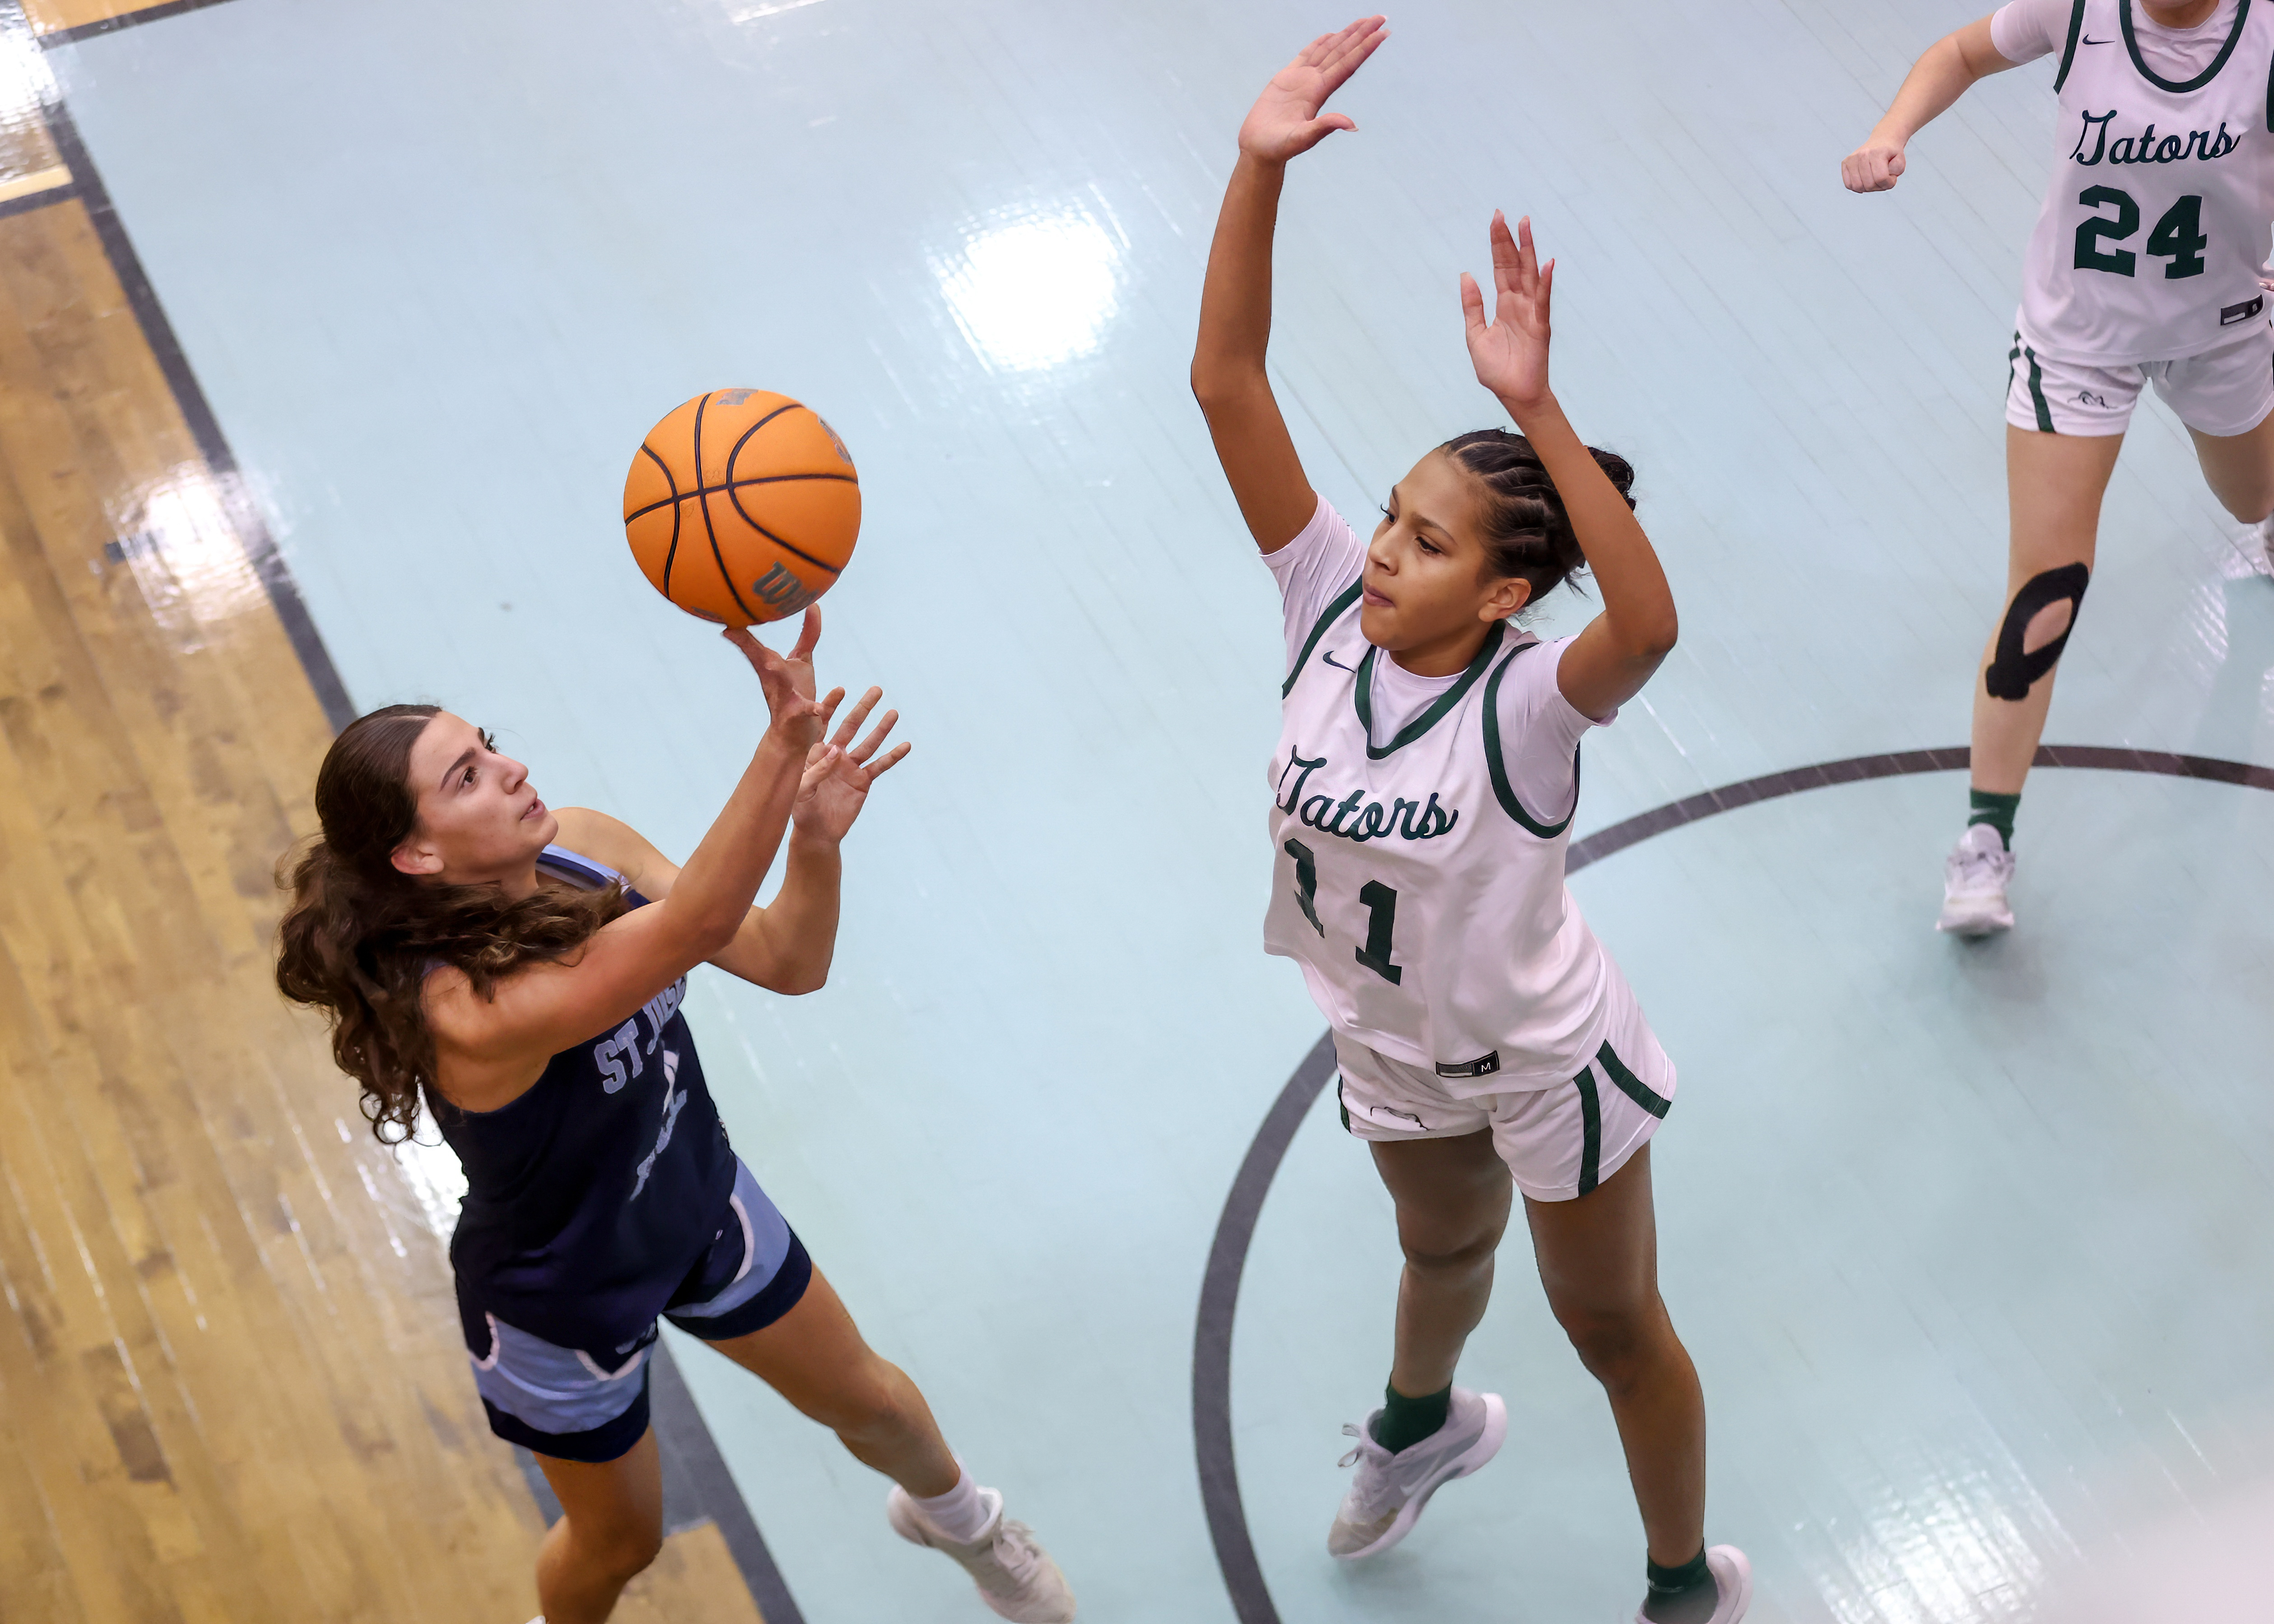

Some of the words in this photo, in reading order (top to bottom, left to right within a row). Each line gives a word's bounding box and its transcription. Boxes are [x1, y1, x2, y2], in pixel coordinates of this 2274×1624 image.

[2069, 110, 2241, 166] Gators
[2074, 184, 2208, 279] 24
[1276, 744, 1459, 842] Gators
[1284, 837, 1402, 986] 11
[594, 1017, 643, 1094] ST
[1481, 1062, 1491, 1072] M
